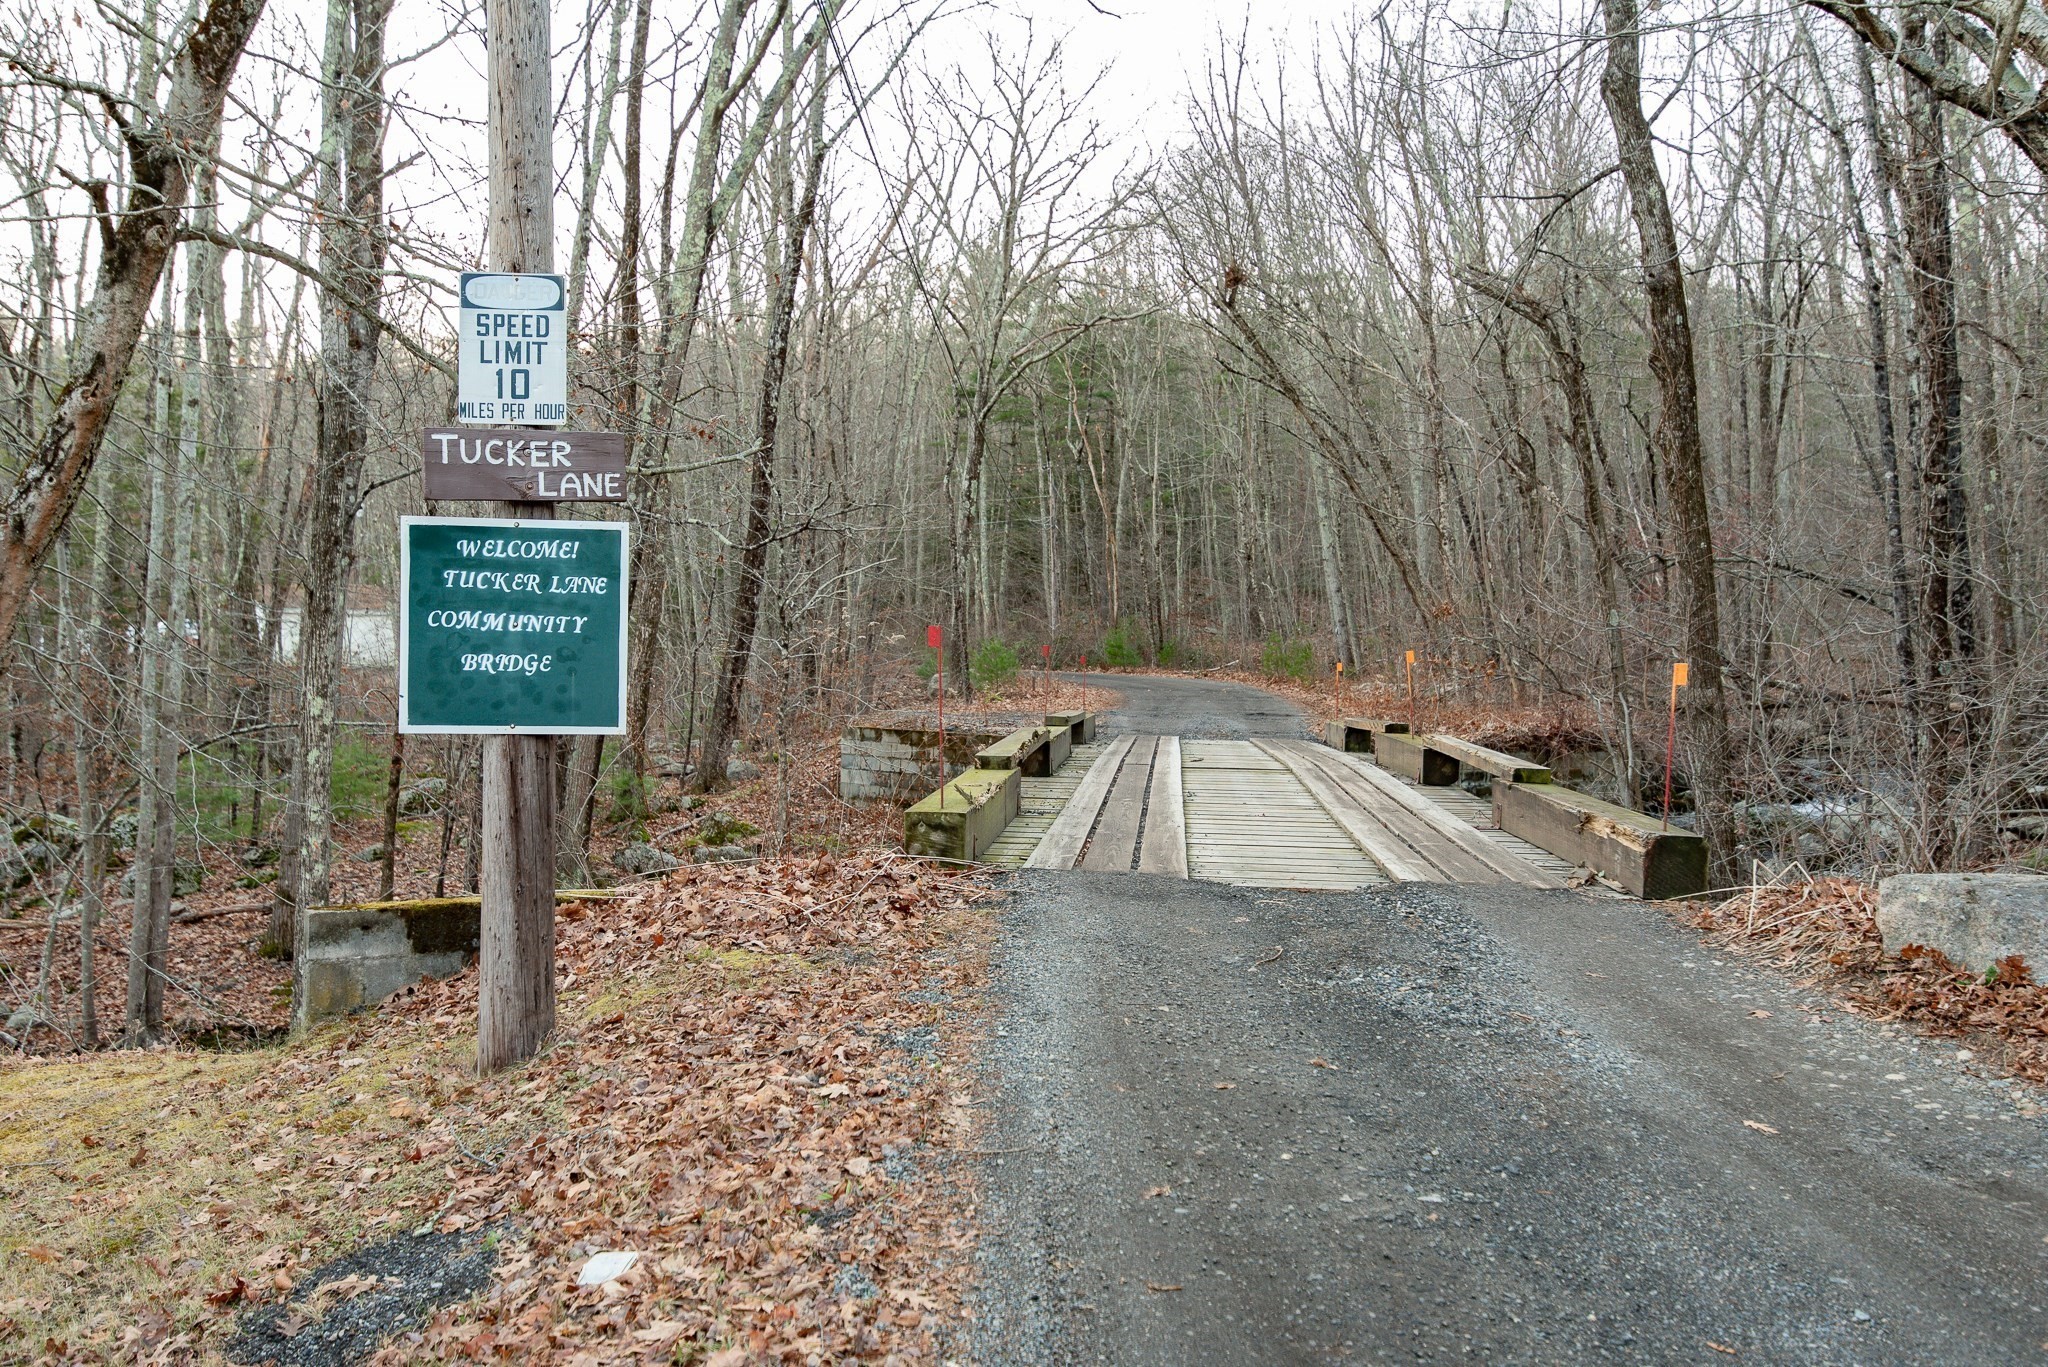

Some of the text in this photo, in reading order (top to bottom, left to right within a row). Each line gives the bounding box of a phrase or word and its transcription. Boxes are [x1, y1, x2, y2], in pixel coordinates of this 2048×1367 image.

[476, 313, 550, 338] SPEED
[480, 340, 548, 365] LIMIT
[495, 368, 530, 400] 10
[459, 402, 565, 420] MILES PER HOUR
[431, 433, 572, 468] TUCKER
[538, 472, 622, 498] LANE
[456, 539, 580, 559] WELCOME!
[444, 569, 607, 595] TUCKER LANE
[427, 610, 588, 634] COMMUNITY
[460, 653, 552, 676] BRIDGE
